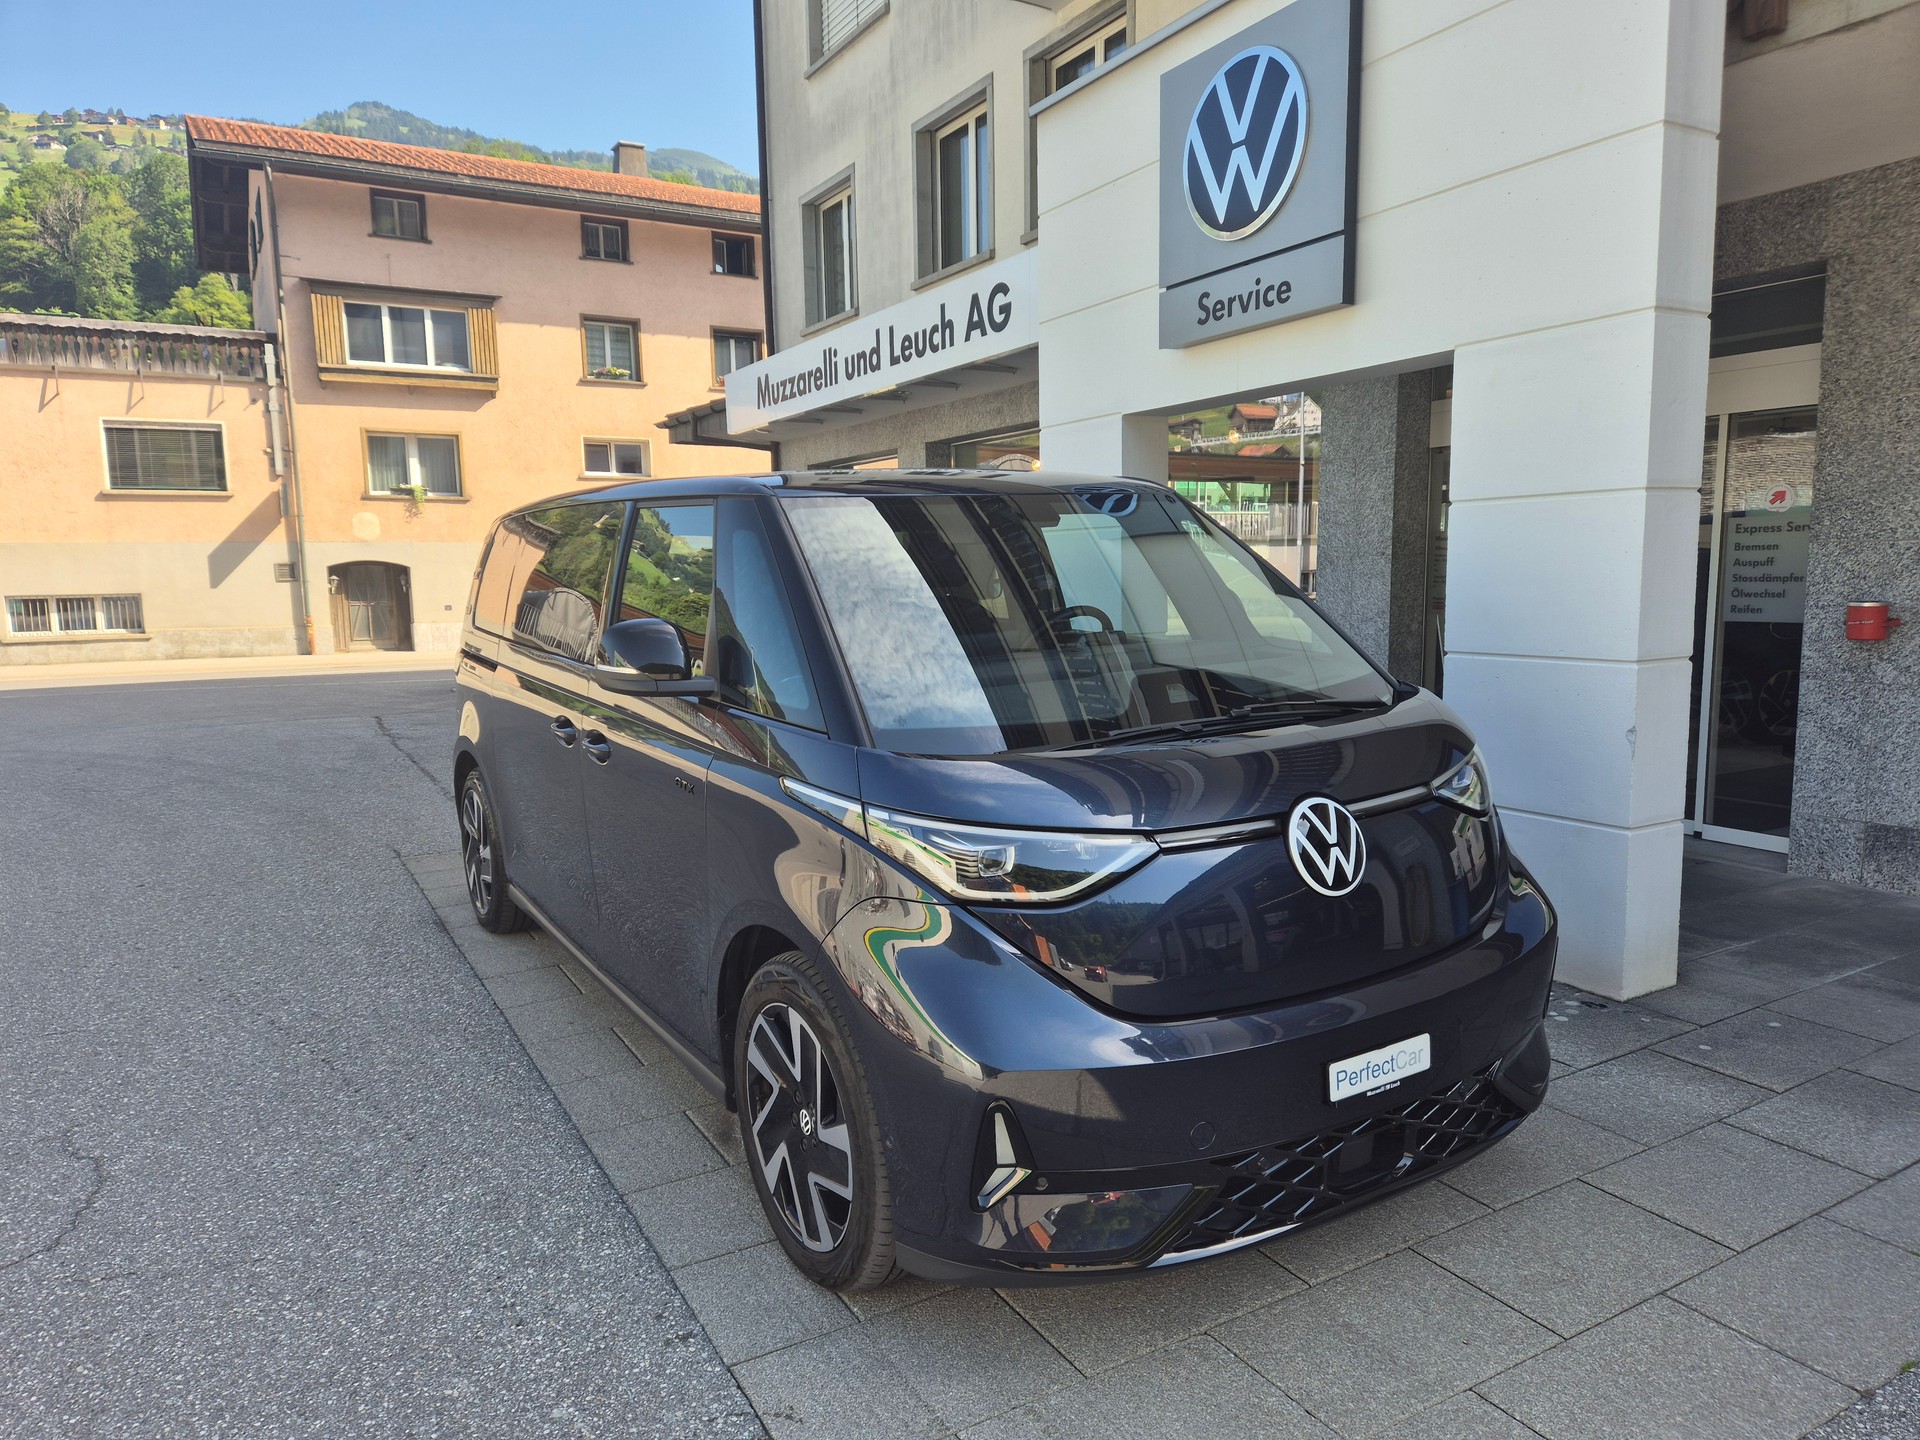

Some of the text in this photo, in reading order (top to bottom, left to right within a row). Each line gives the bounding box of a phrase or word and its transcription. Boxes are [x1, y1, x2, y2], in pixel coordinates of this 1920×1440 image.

[1197, 277, 1292, 326] Service
[757, 281, 1012, 410] Muzzarelli und Leuch AG
[1735, 523, 1782, 536] Express
[1734, 543, 1779, 551] Bremsen
[1733, 557, 1775, 569] Auspuff
[1732, 572, 1805, 584] Stossdämpfer
[1731, 587, 1786, 598] Ölwechsel
[1730, 604, 1763, 614] Reifen
[1336, 1048, 1424, 1091] PerfectCar
